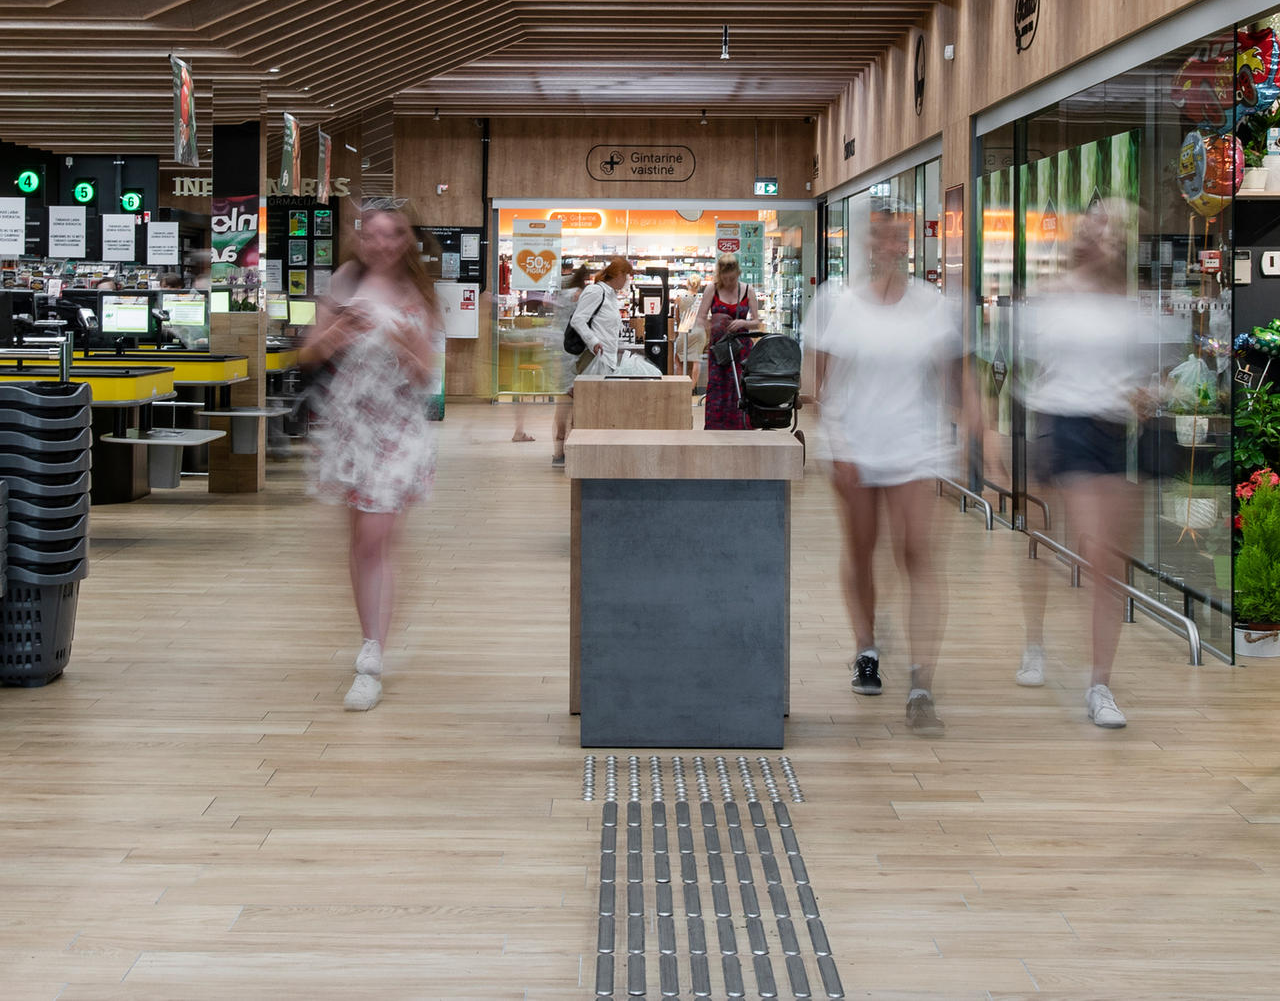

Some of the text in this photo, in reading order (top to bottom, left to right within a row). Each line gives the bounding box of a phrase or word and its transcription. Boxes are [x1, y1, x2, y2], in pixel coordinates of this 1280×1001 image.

[630, 151, 683, 164] Gintarinė
[631, 164, 675, 175] vaistinė
[23, 175, 32, 188] 4
[80, 186, 88, 198] 5
[127, 196, 135, 208] 6
